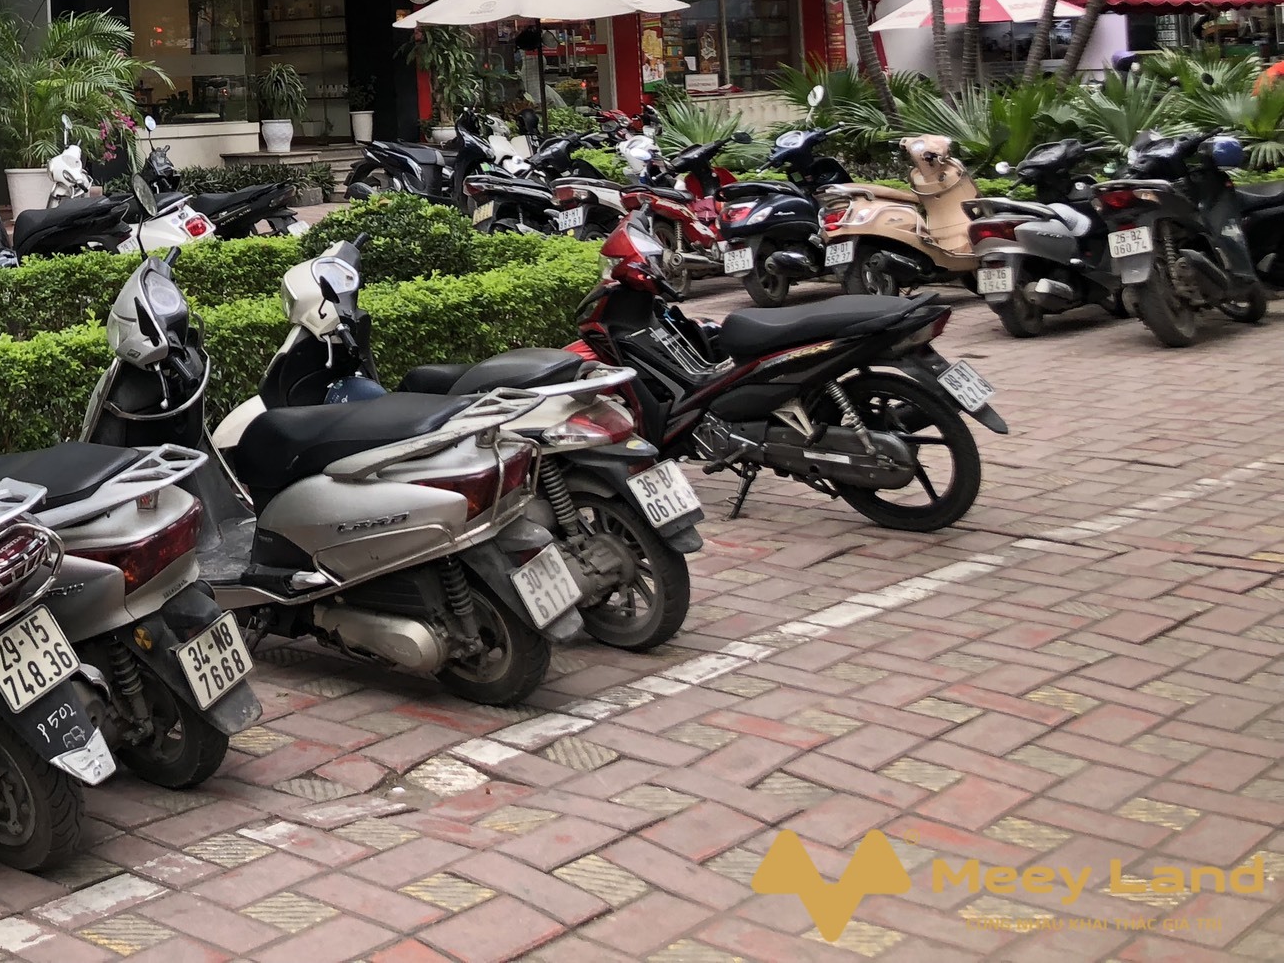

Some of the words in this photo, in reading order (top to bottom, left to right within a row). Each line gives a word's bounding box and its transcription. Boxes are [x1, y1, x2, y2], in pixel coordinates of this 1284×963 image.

[522, 551, 561, 595] 30-L6
[534, 577, 576, 619] 6112
[188, 621, 234, 672] 34-N8
[2, 641, 73, 706] 748.36
[198, 649, 246, 699] 7668
